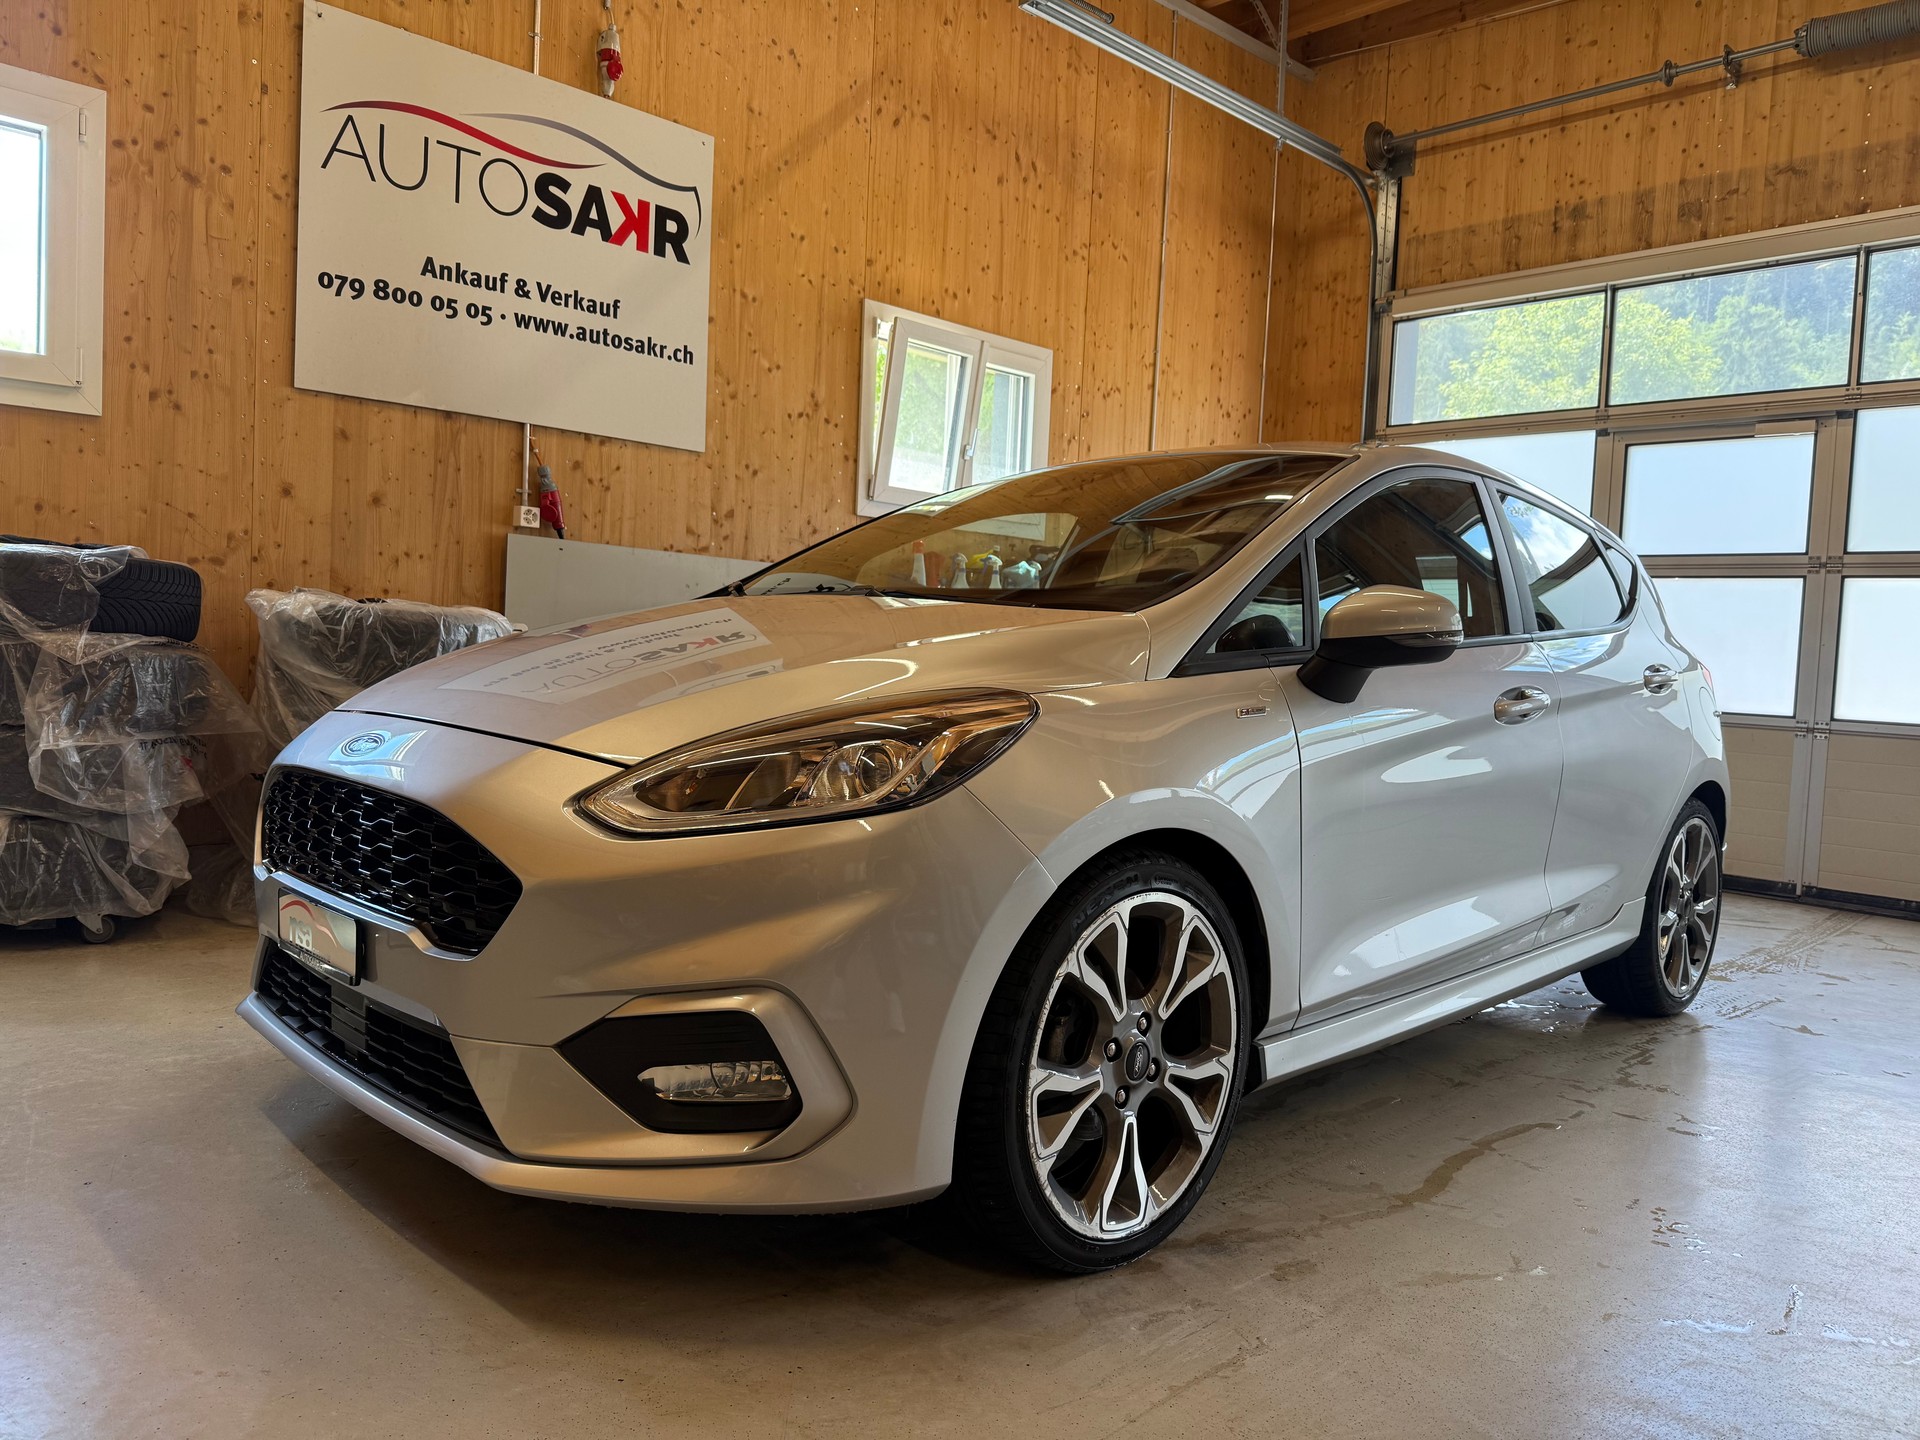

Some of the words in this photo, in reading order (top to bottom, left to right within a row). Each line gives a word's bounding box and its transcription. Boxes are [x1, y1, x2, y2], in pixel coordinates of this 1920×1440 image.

[321, 115, 690, 265] AUTOSAKR
[318, 271, 365, 300] 079
[373, 279, 423, 308] 800
[431, 294, 459, 319] 05
[466, 302, 493, 326] 05
[514, 312, 694, 365] www.autosakr.ch
[420, 256, 509, 294] Ankauf
[514, 279, 531, 299] &
[536, 282, 621, 319] Verkauf
